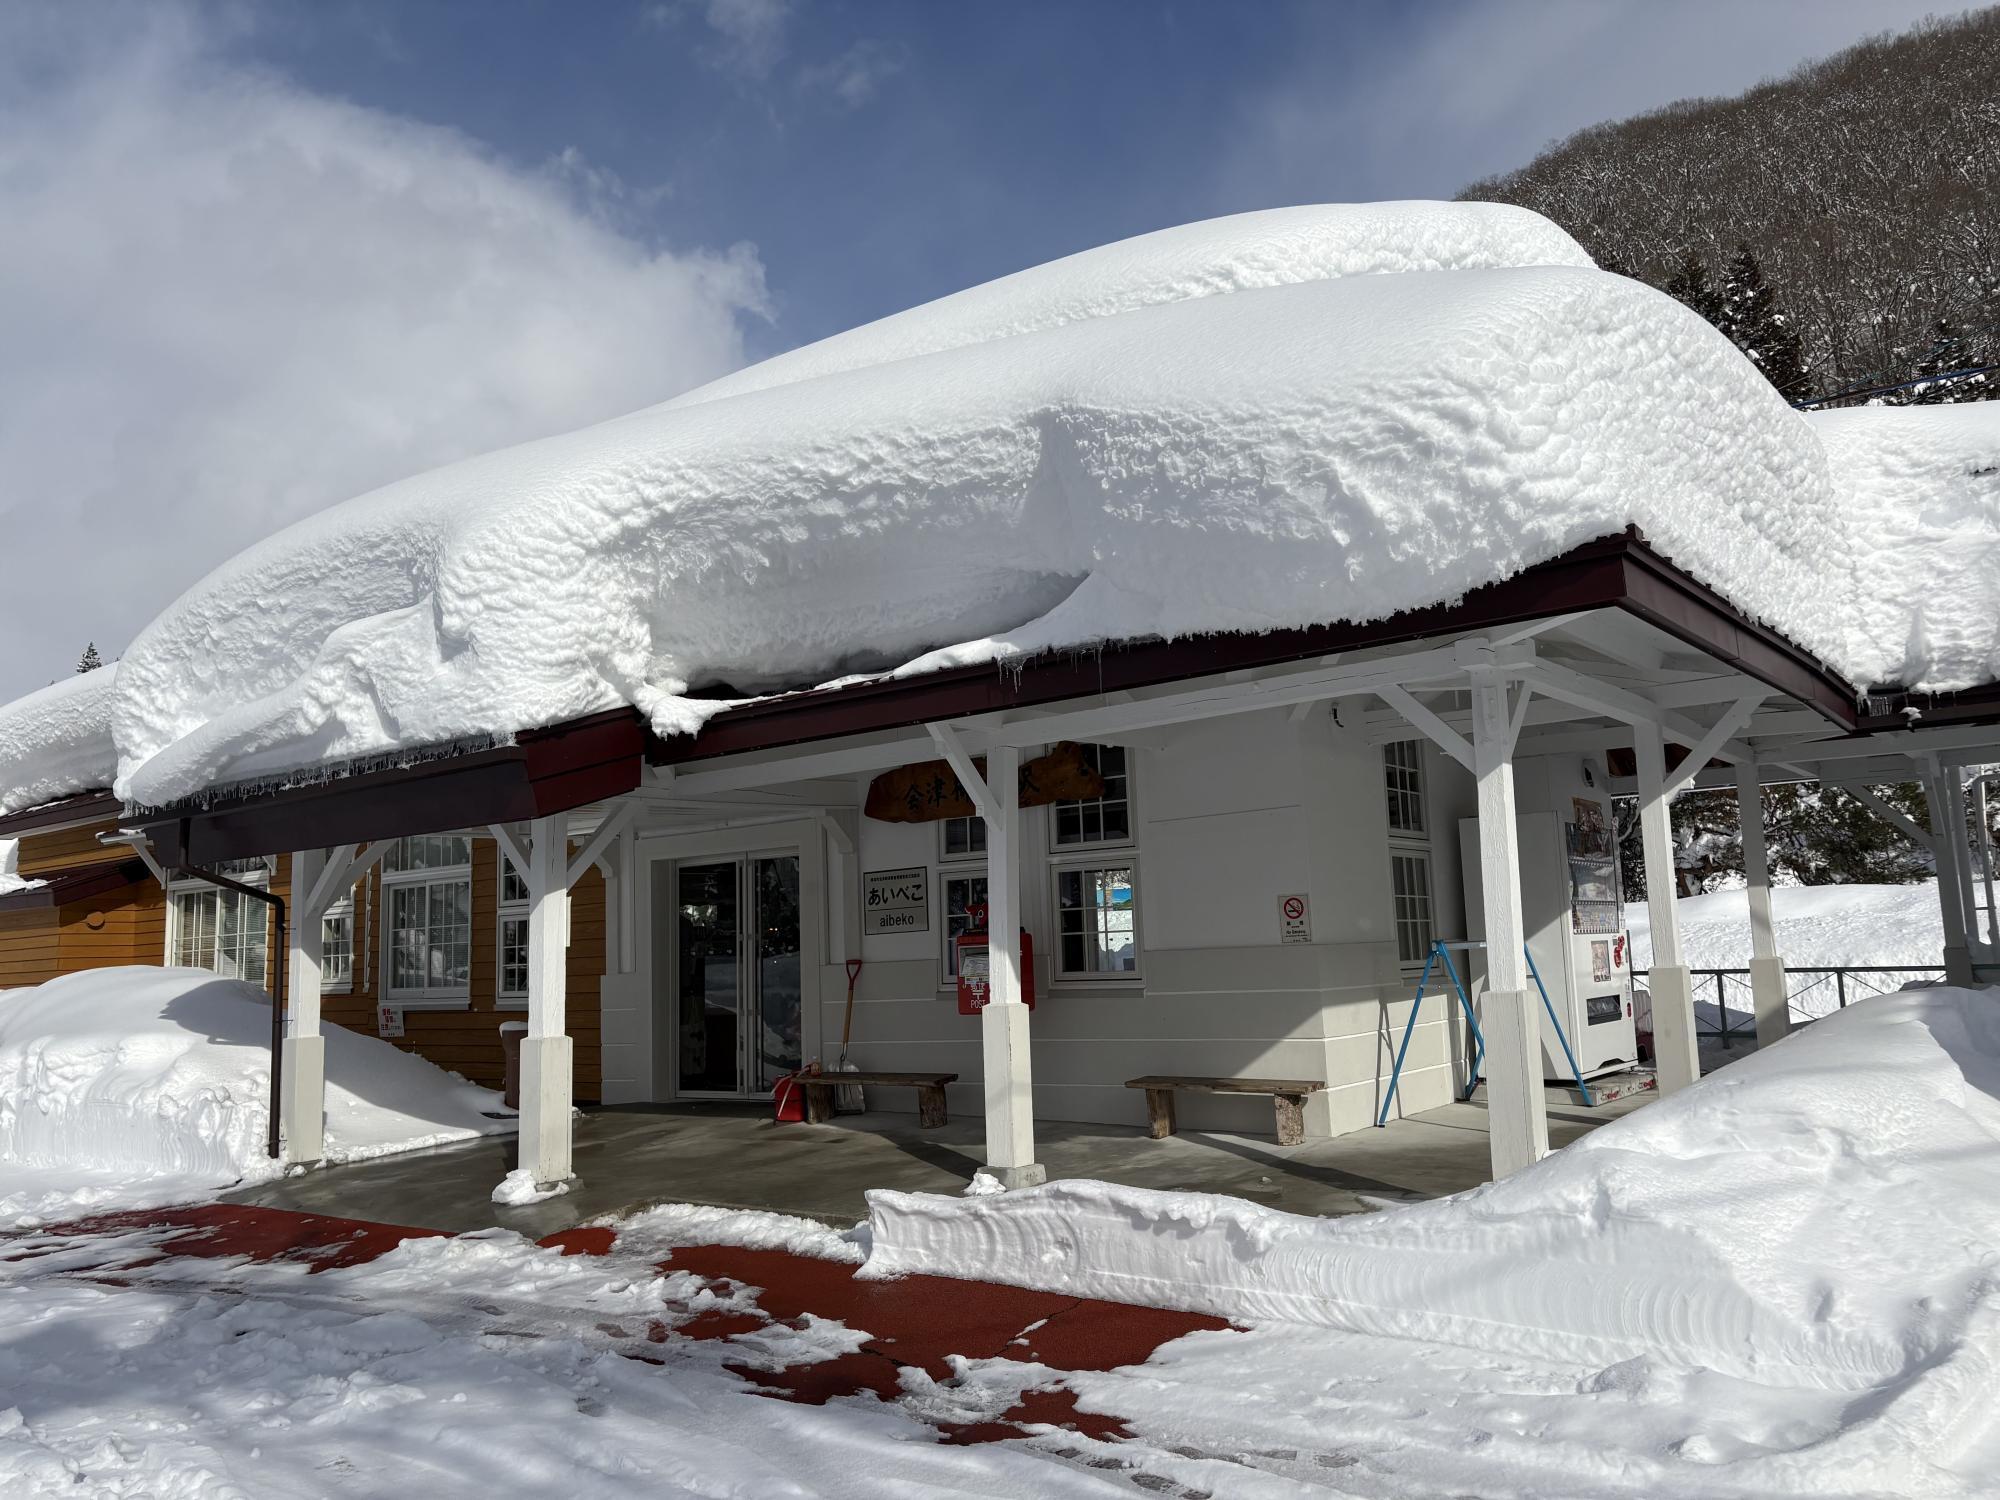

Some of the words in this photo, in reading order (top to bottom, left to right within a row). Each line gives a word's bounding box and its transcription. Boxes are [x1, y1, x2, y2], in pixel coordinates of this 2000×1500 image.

[868, 884, 923, 906] あいべこ
[879, 913, 914, 927] aibeko
